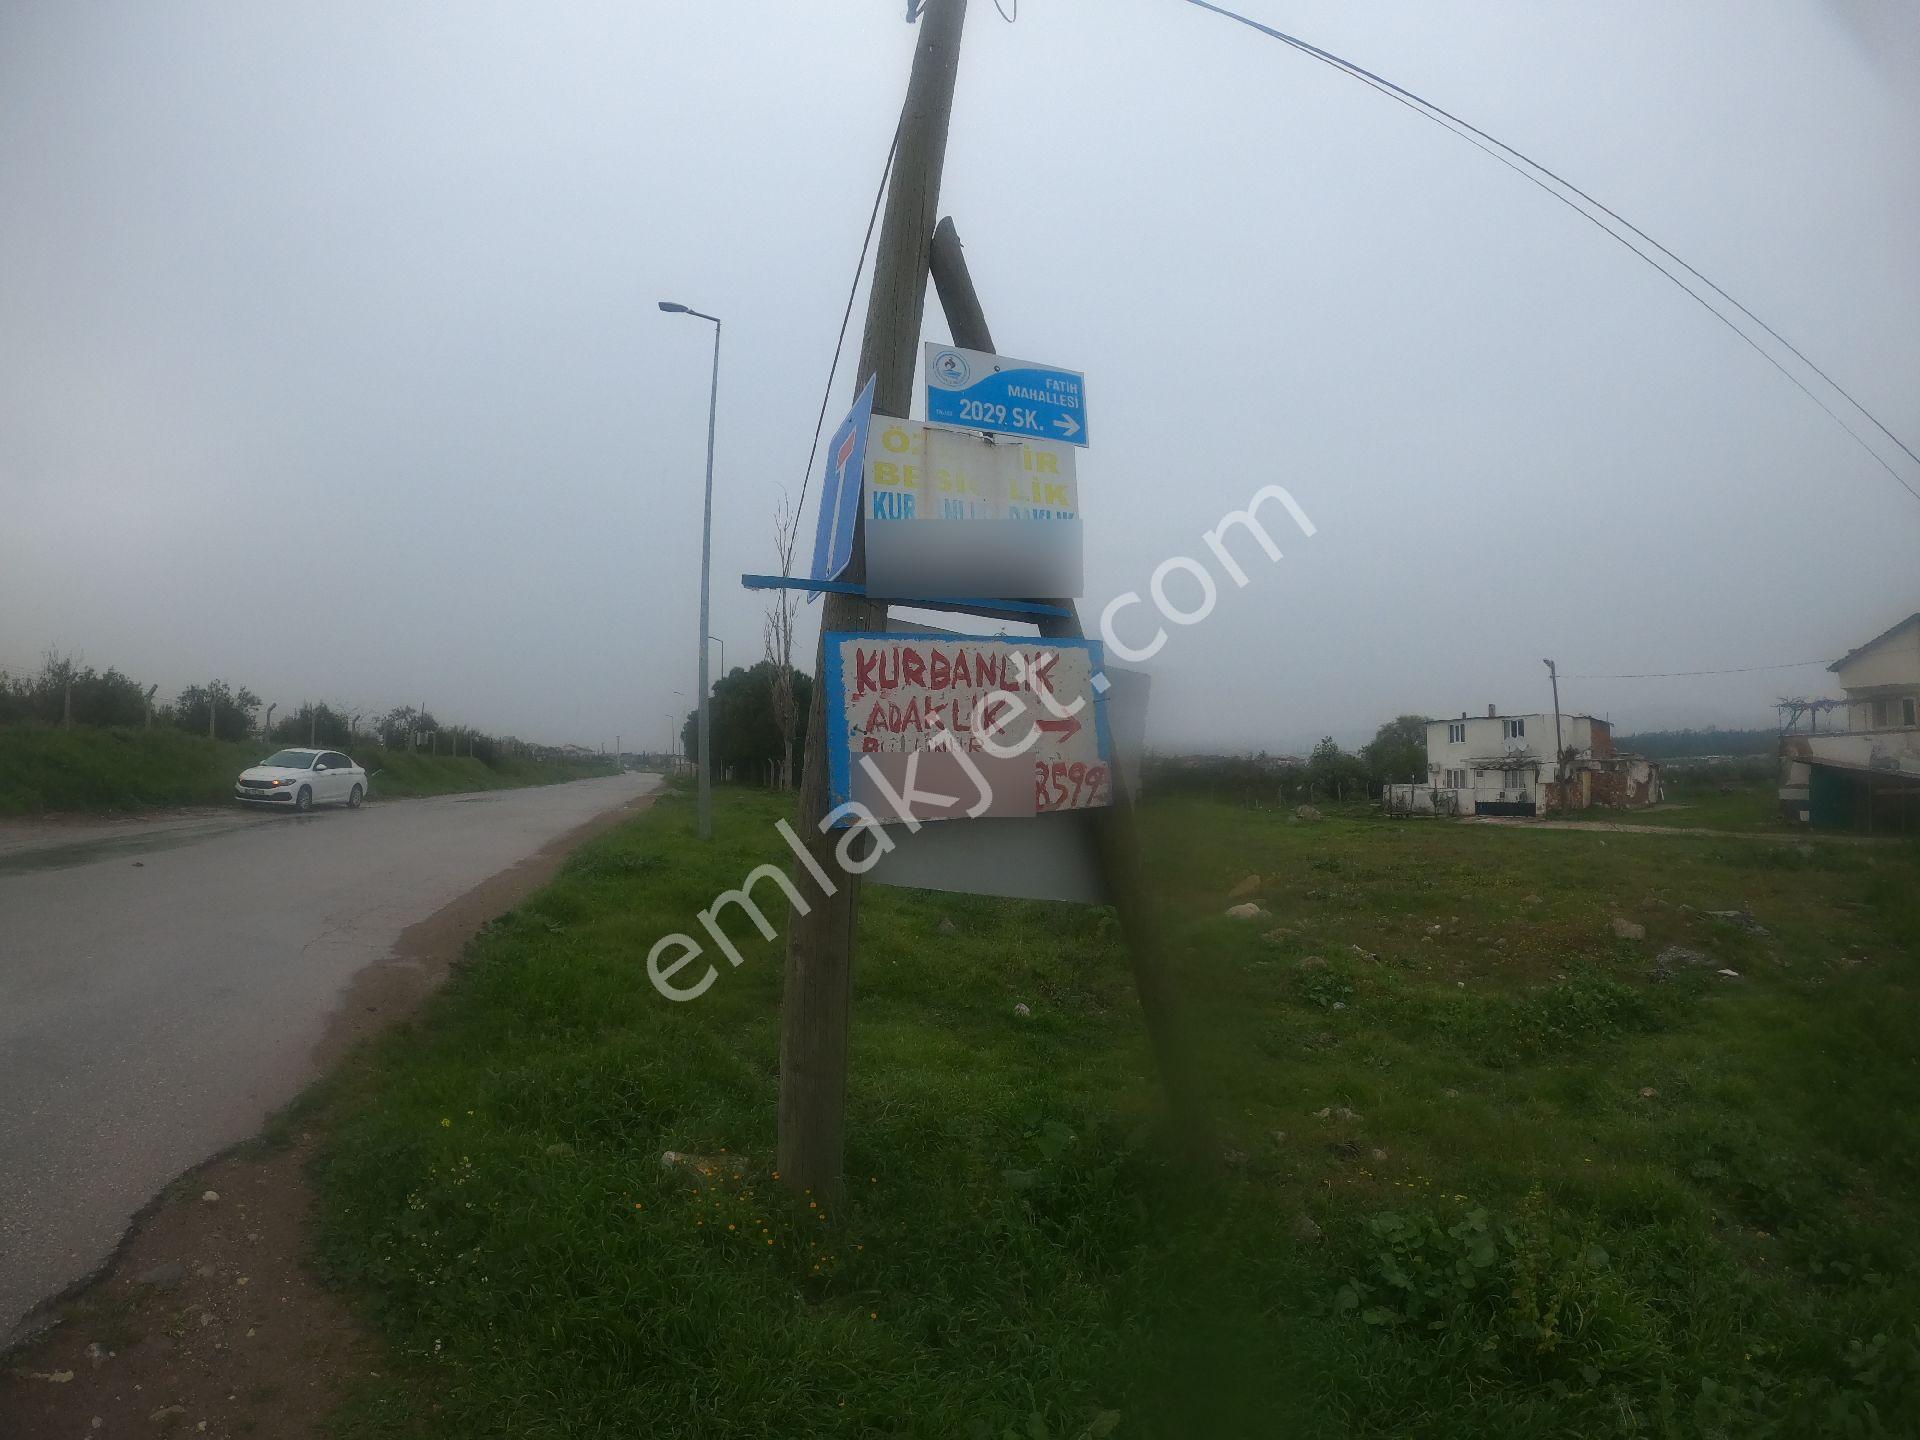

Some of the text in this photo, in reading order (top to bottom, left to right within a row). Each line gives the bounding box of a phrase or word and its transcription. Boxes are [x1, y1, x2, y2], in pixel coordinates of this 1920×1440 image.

[1045, 378, 1078, 395] FATİH
[1012, 407, 1044, 431] SK.
[855, 647, 1060, 696] KURBANLIK
